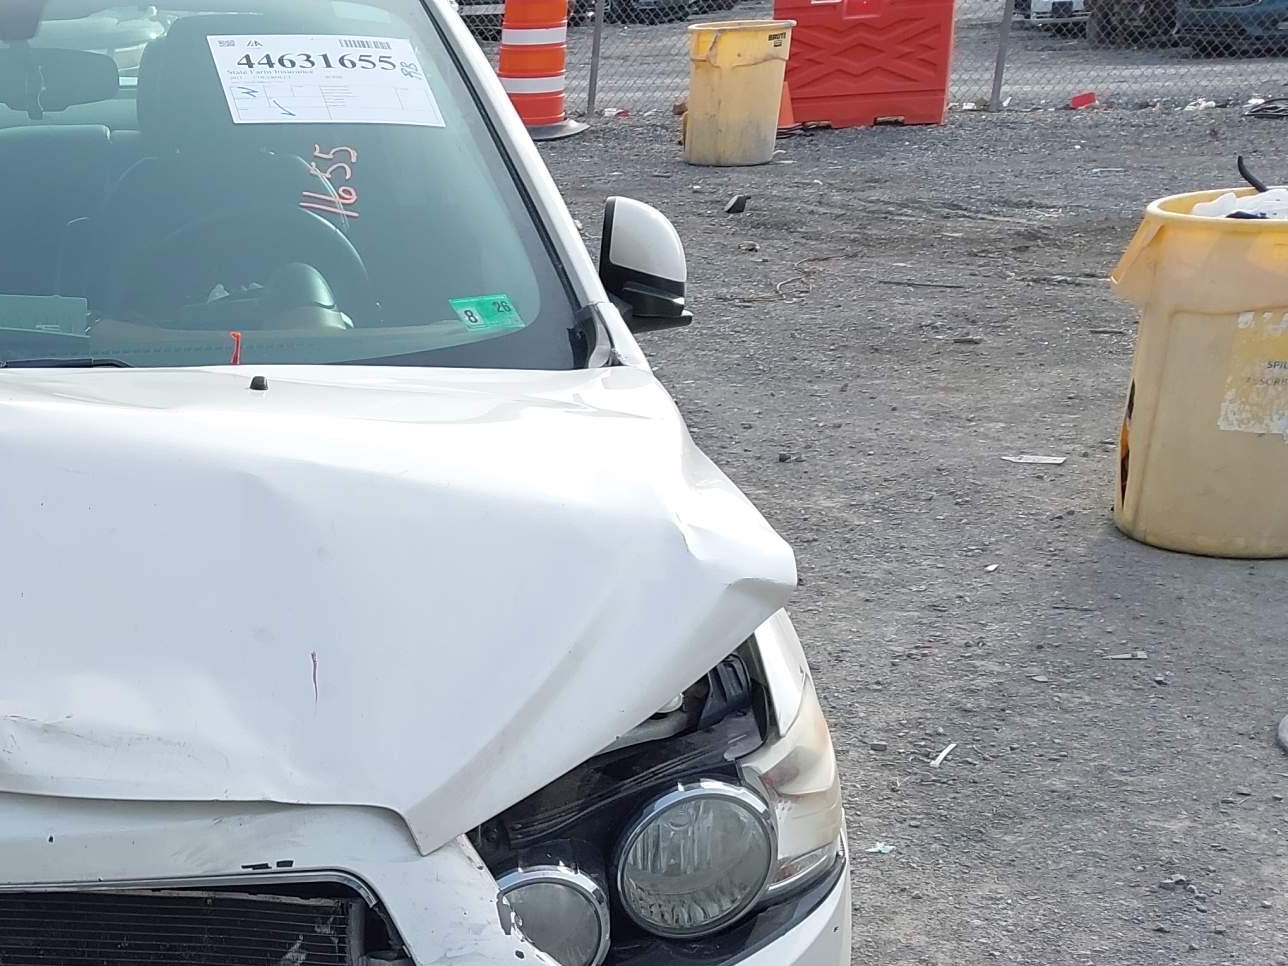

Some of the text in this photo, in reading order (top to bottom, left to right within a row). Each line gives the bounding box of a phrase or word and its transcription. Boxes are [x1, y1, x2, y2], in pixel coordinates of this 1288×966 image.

[237, 53, 396, 70] 44631655
[493, 300, 511, 312] 26
[464, 309, 478, 323] 8
